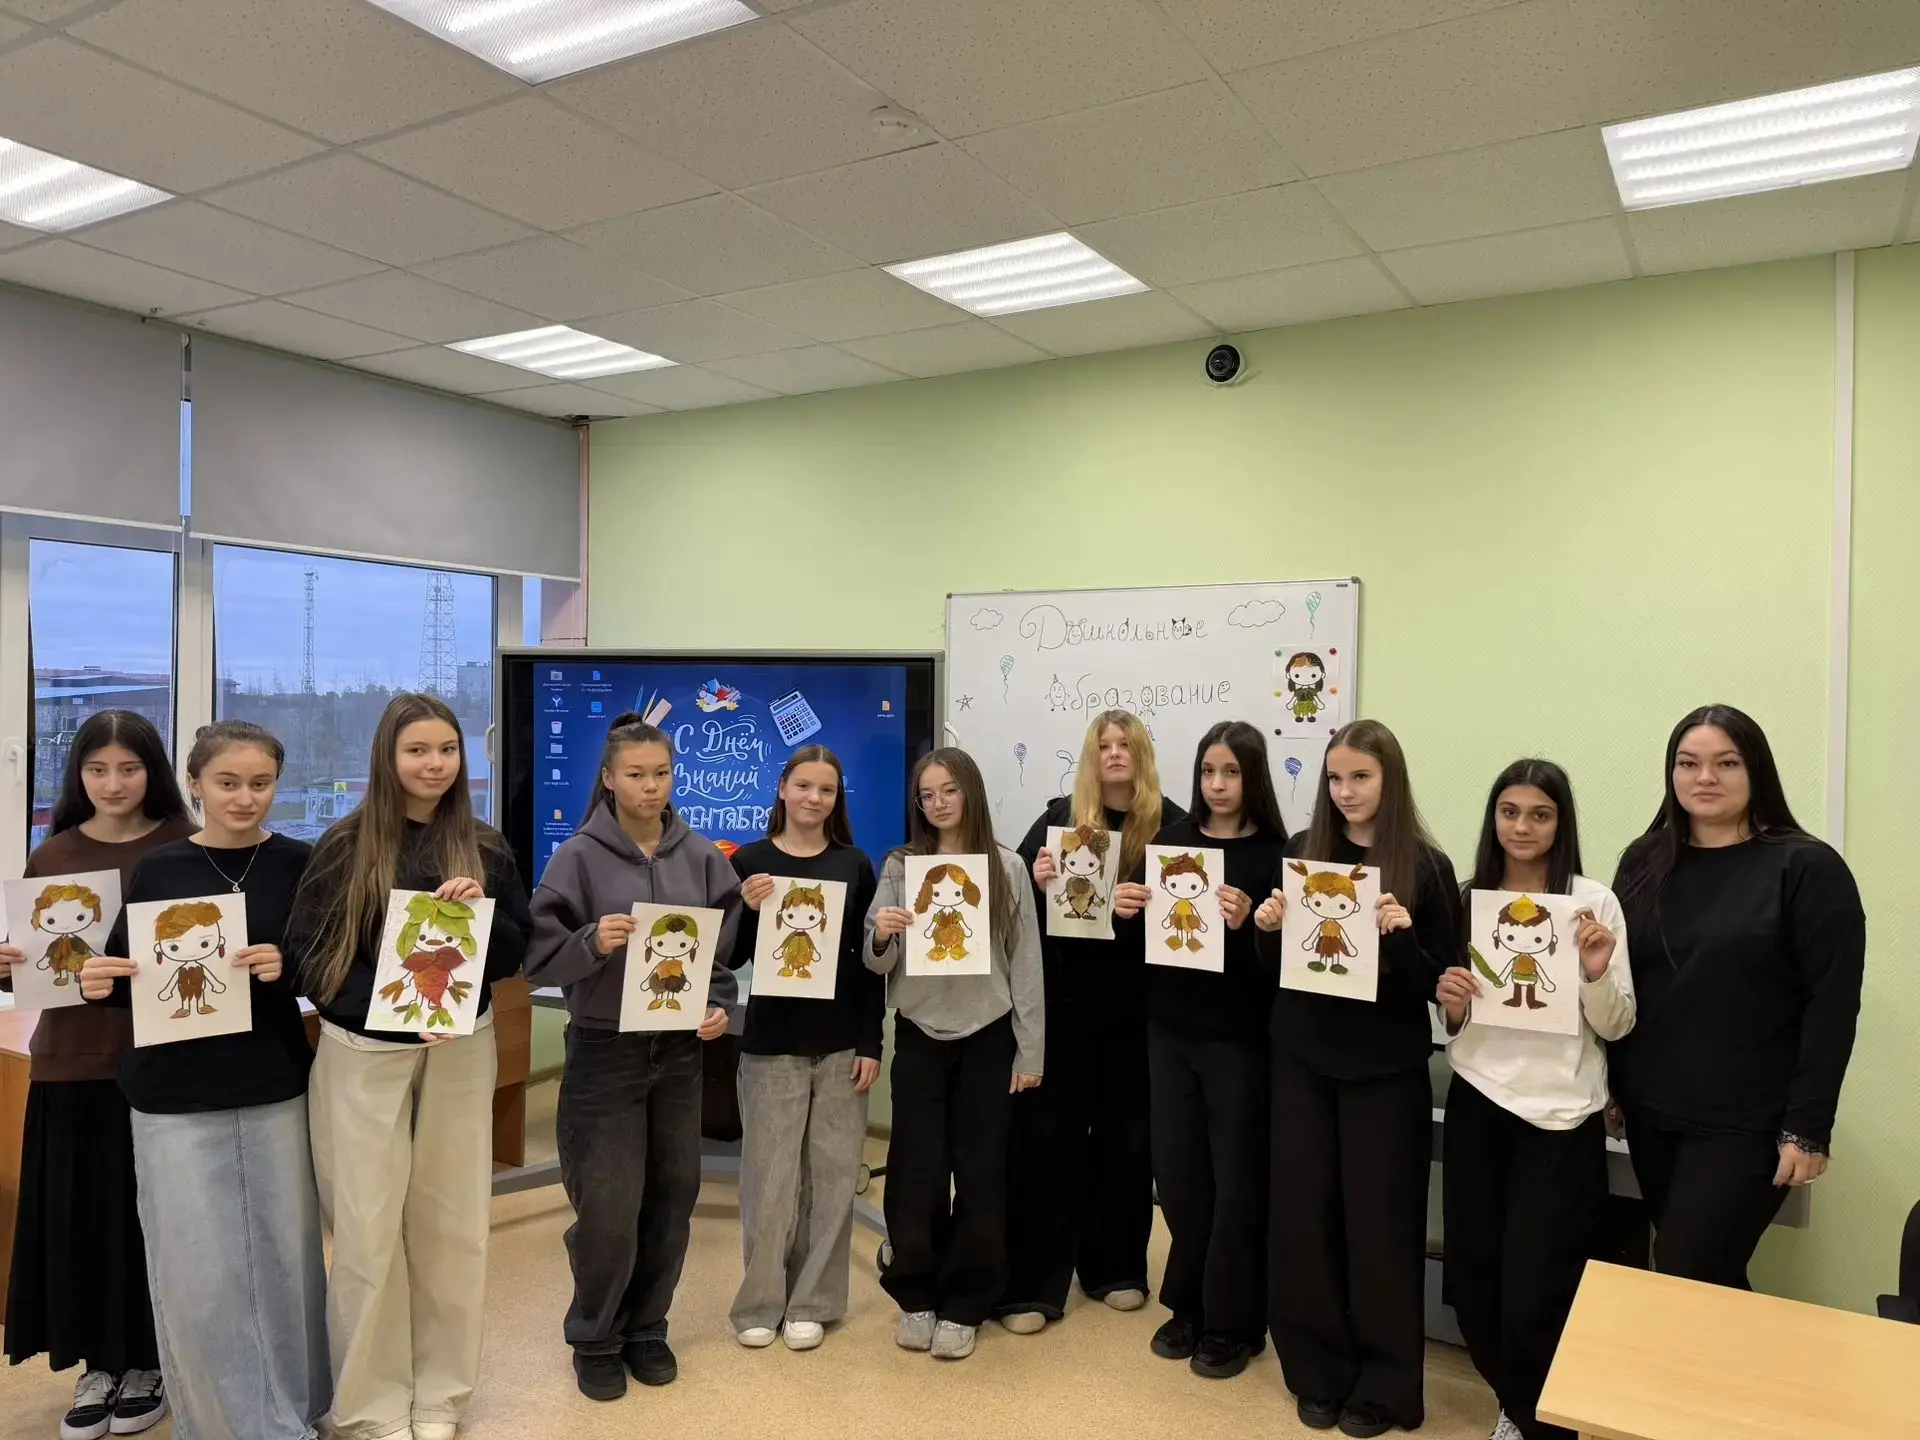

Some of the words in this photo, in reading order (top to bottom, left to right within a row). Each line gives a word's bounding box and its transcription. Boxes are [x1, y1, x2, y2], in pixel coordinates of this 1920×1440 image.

[1045, 673, 1231, 721] Образование
[674, 723, 695, 755] С
[696, 719, 764, 762] Днём
[673, 762, 760, 801] Знаний
